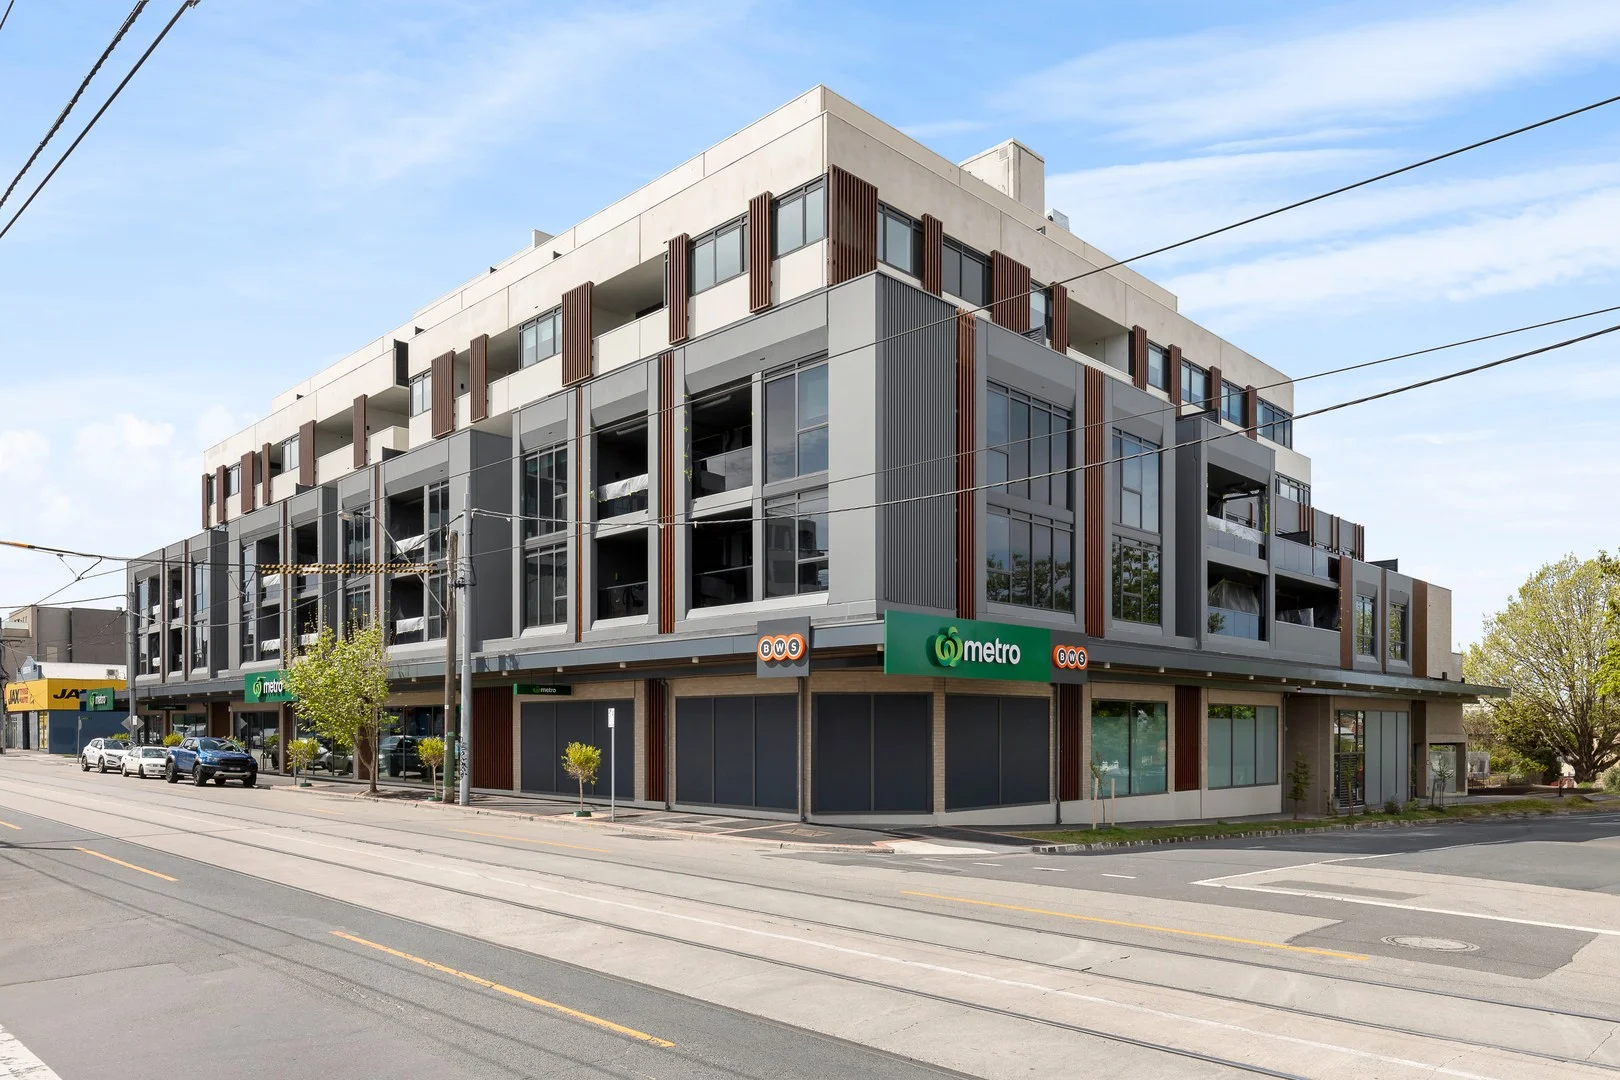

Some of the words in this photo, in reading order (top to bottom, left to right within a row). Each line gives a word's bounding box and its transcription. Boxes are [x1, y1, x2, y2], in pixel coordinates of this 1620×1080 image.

[963, 638, 1021, 665] metro
[263, 679, 283, 693] metro
[8, 689, 20, 705] JAX
